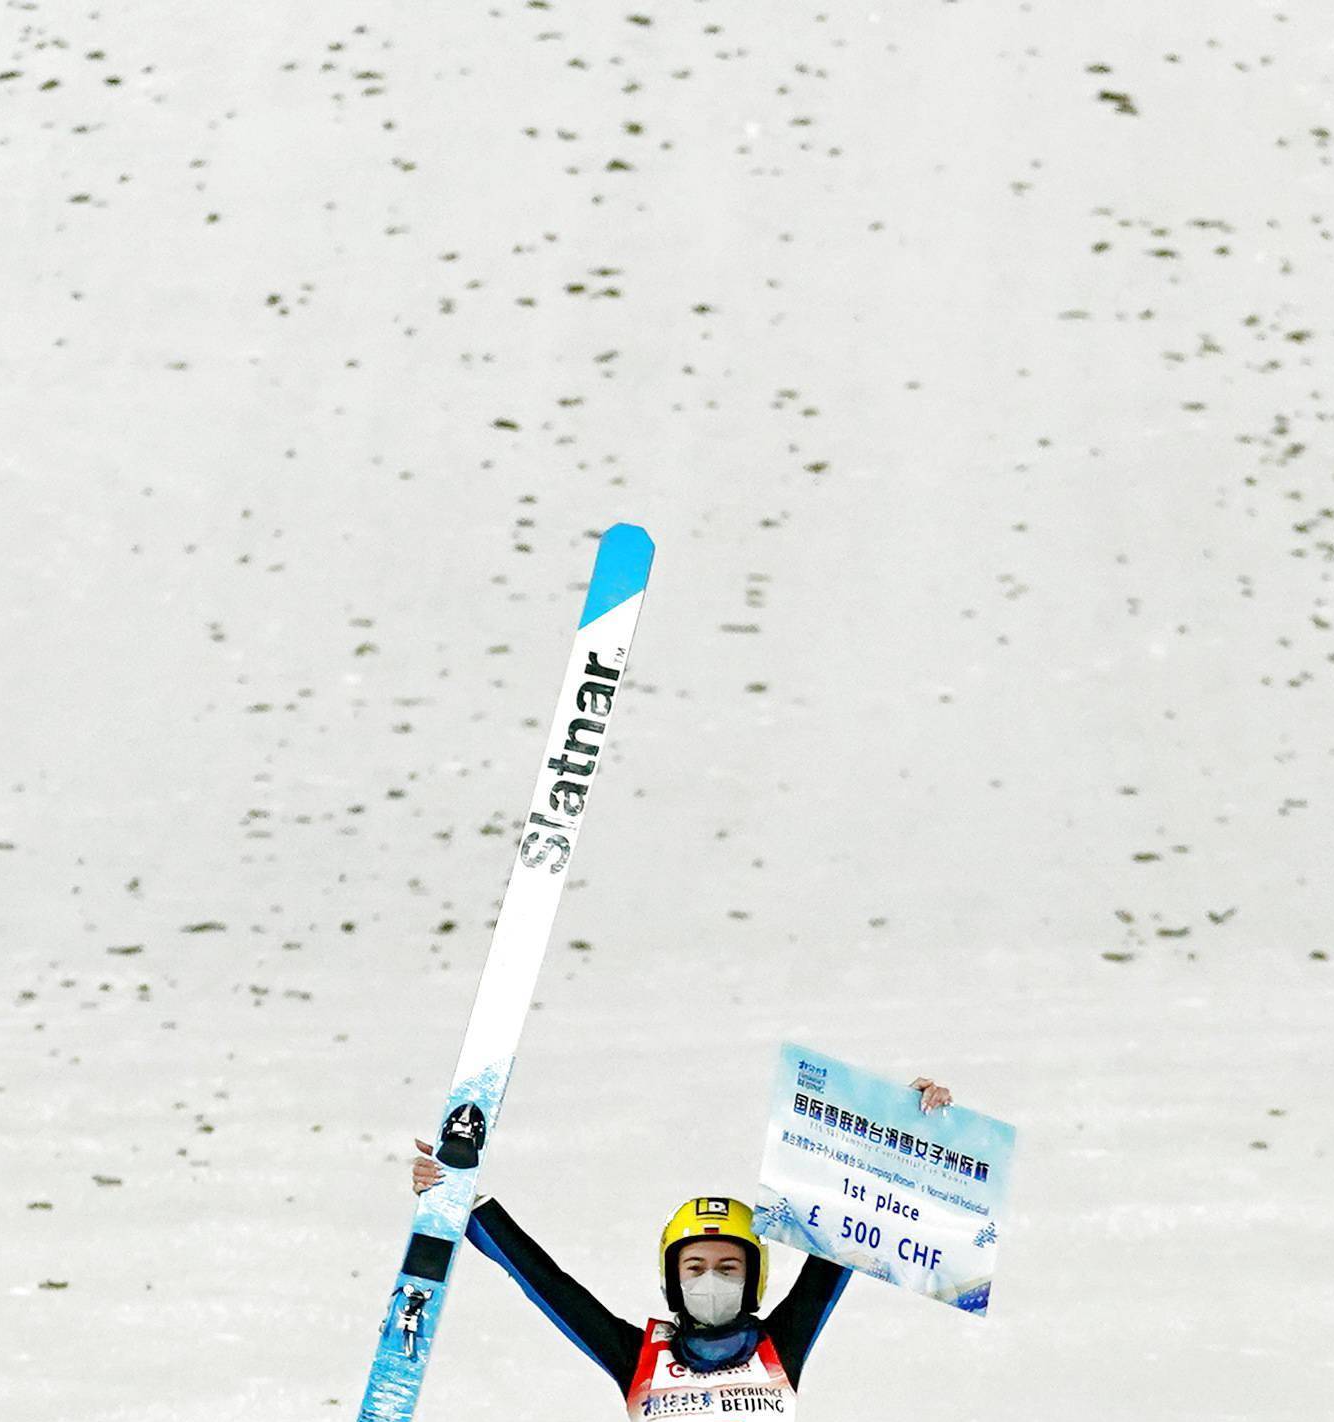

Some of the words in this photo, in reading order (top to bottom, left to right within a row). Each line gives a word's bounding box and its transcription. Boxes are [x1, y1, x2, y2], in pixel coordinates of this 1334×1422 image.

[520, 651, 621, 874] Slatnar
[843, 1178, 865, 1202] 1st
[875, 1193, 920, 1221] place
[808, 1205, 821, 1227] £
[841, 1216, 881, 1249] 500
[897, 1238, 943, 1270] CHF
[720, 1387, 783, 1399] EXPERIENCE
[722, 1398, 784, 1414] BEIJING
